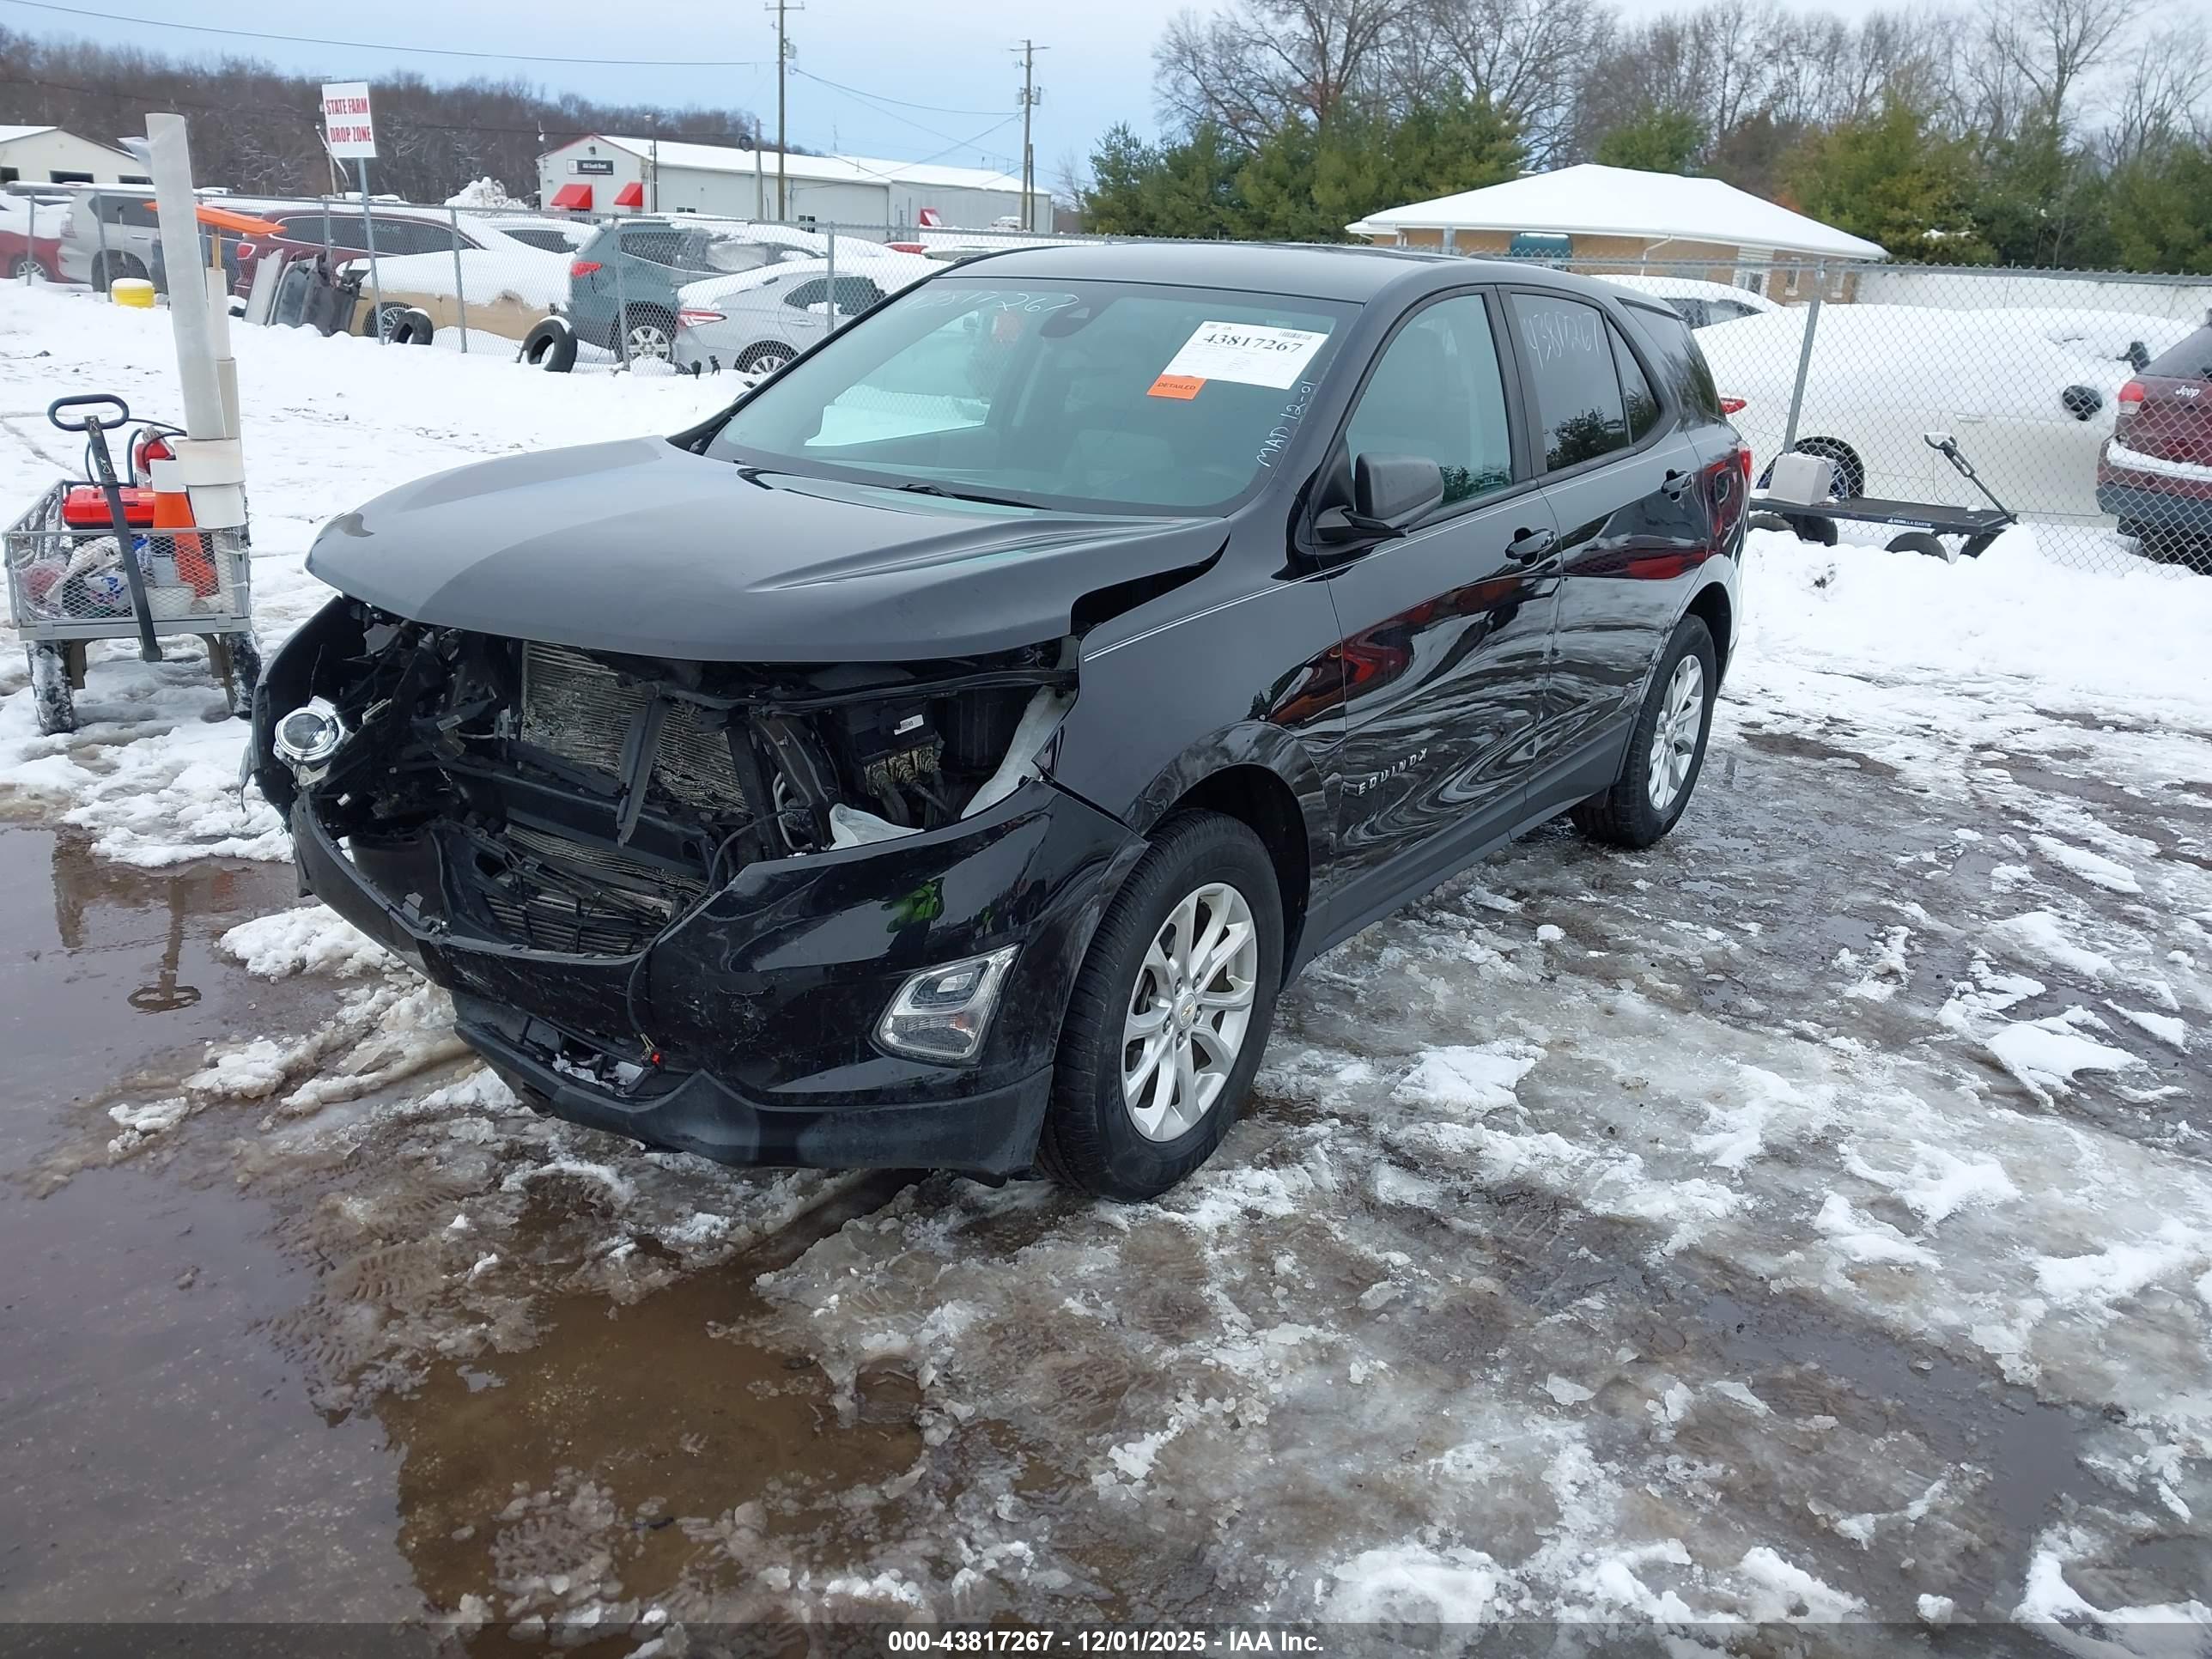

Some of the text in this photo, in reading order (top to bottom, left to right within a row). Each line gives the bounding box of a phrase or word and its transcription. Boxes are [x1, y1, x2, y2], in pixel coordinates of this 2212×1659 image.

[325, 97, 368, 115] STATE FARM
[330, 126, 372, 143] DROP ZONE
[1203, 333, 1304, 354] 43817267
[1157, 381, 1196, 391] DETAILED
[2175, 385, 2201, 398] Jeep
[1256, 380, 1316, 467] MAD 12-01
[1358, 747, 1428, 796] EQUINOX
